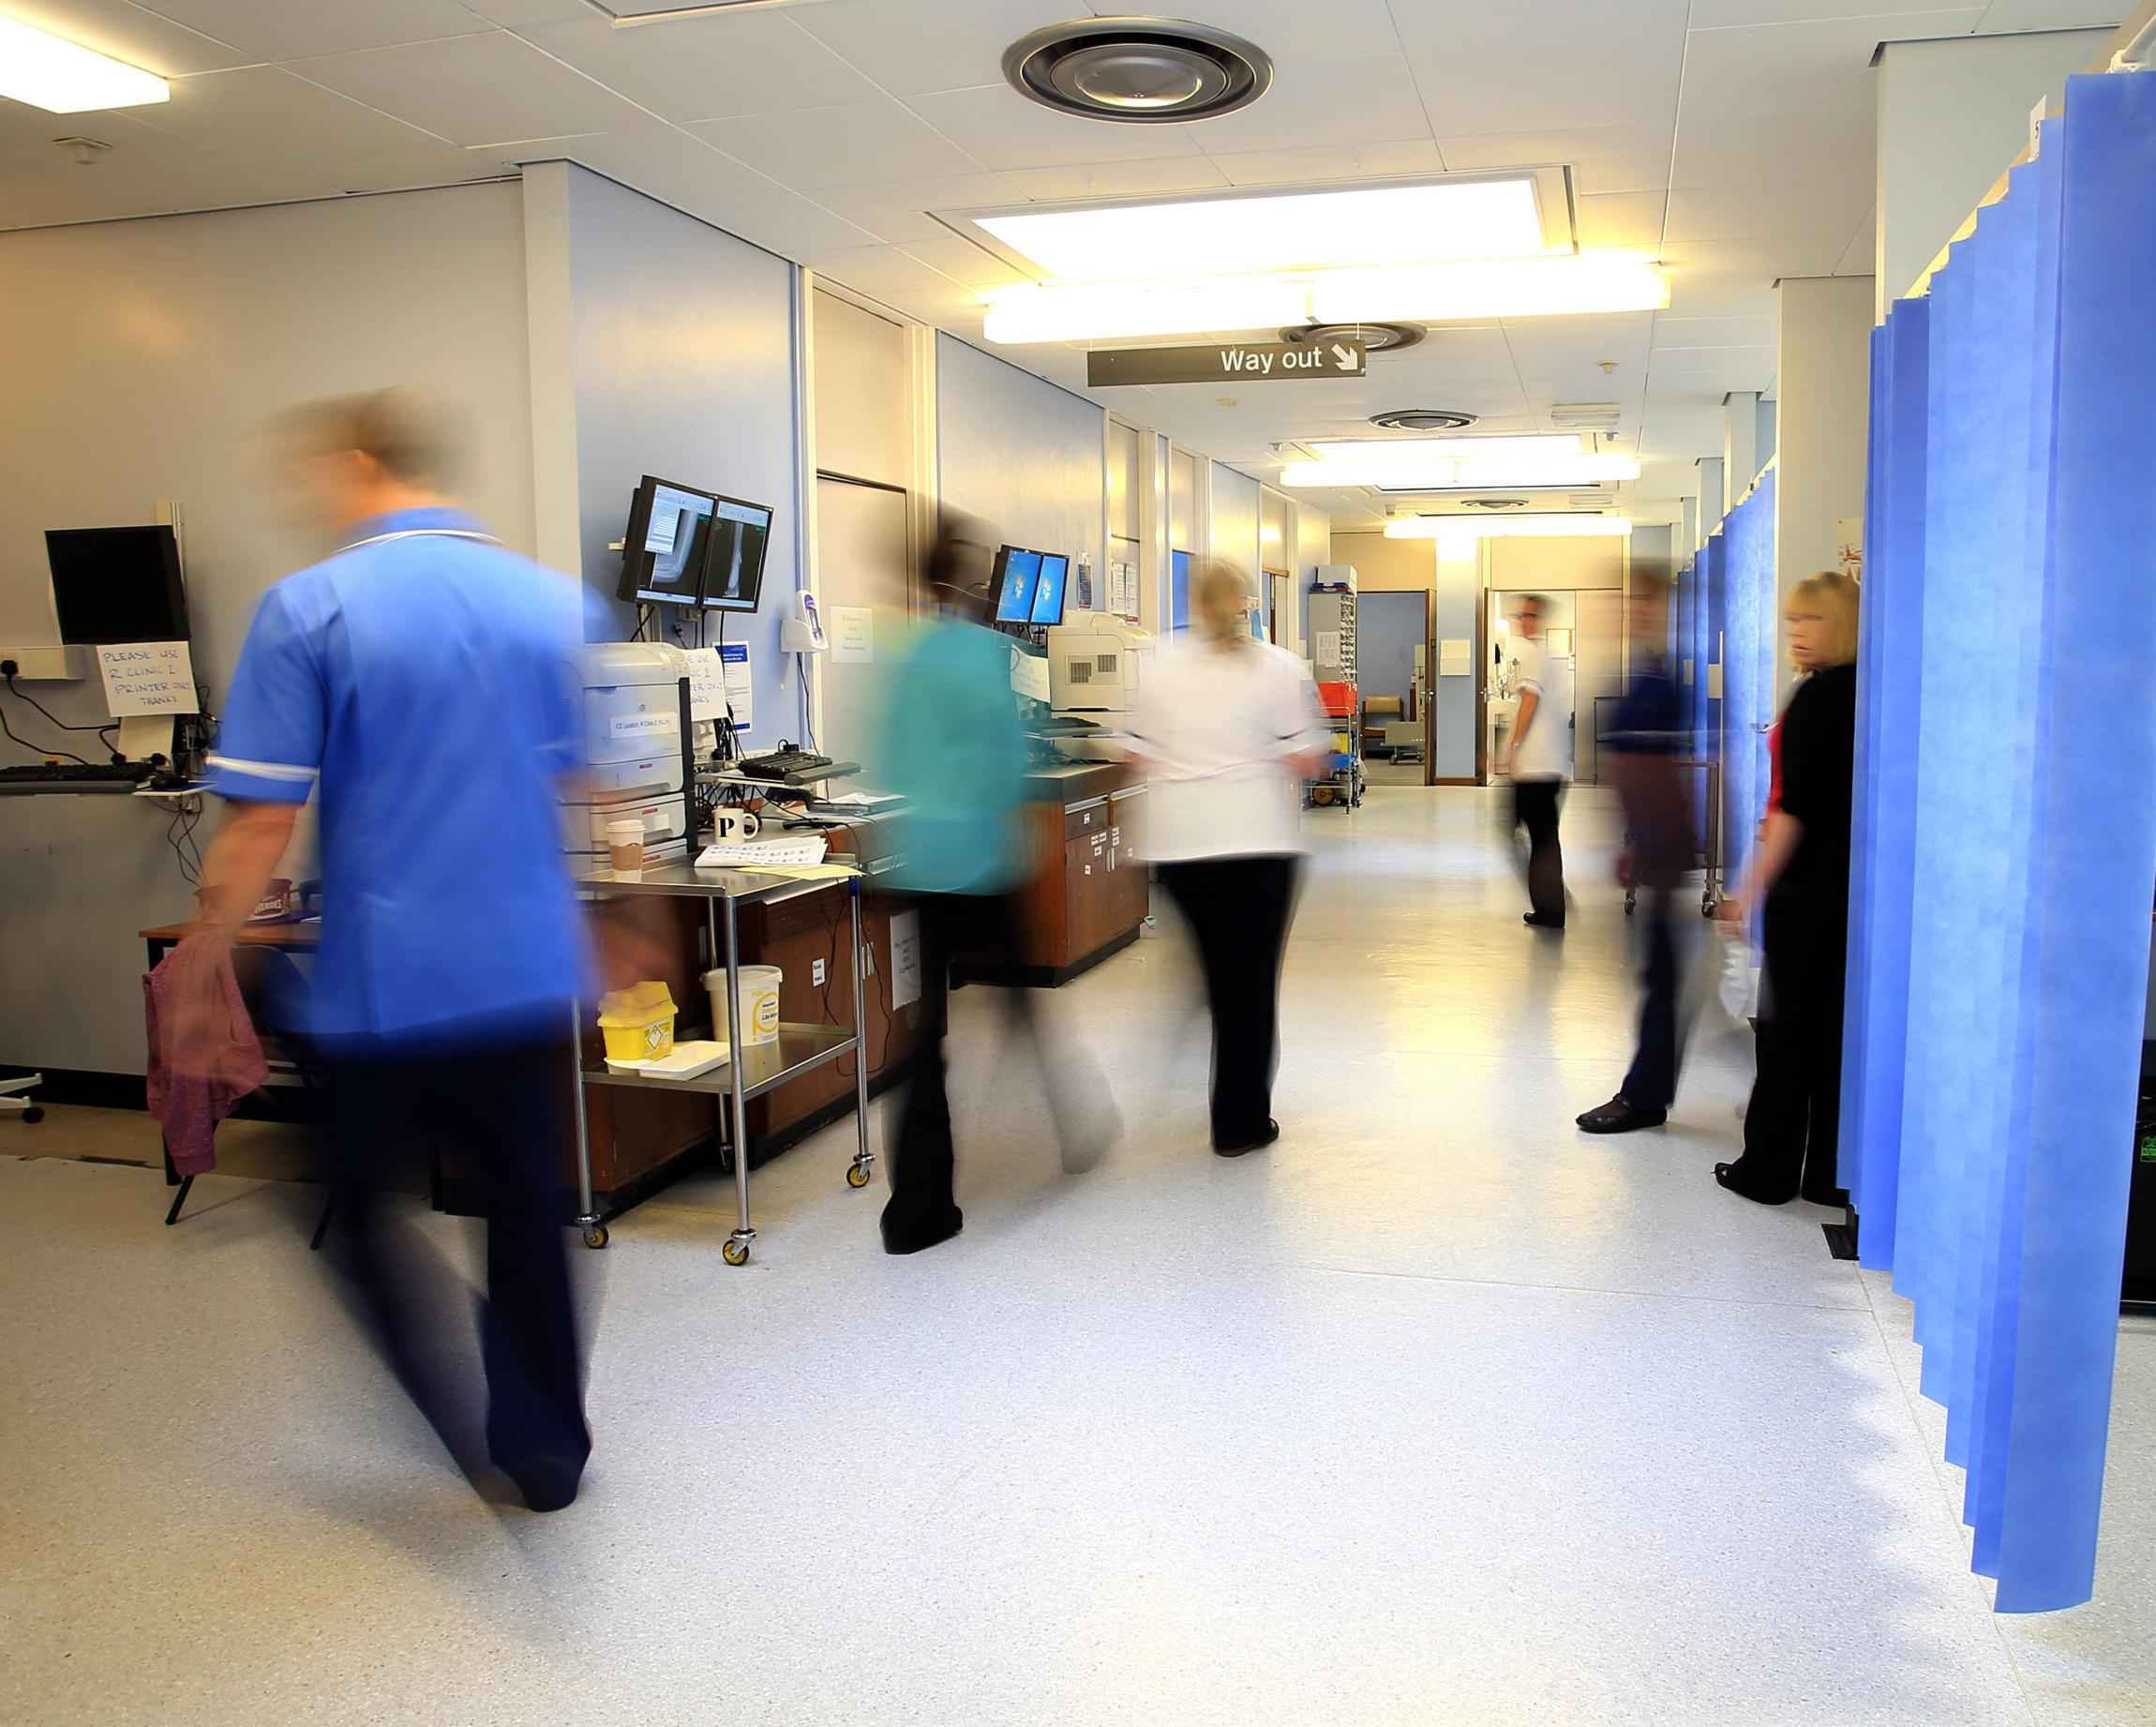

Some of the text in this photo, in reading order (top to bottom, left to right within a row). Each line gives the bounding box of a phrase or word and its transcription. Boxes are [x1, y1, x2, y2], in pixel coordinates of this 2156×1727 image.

[1220, 346, 1323, 374] Way out
[103, 650, 179, 662] PLEASE USE
[127, 667, 162, 677] CLINIC
[705, 668, 711, 678] 2
[115, 683, 169, 694] PRINTER
[140, 697, 177, 705] THANKS
[718, 817, 735, 837] P
